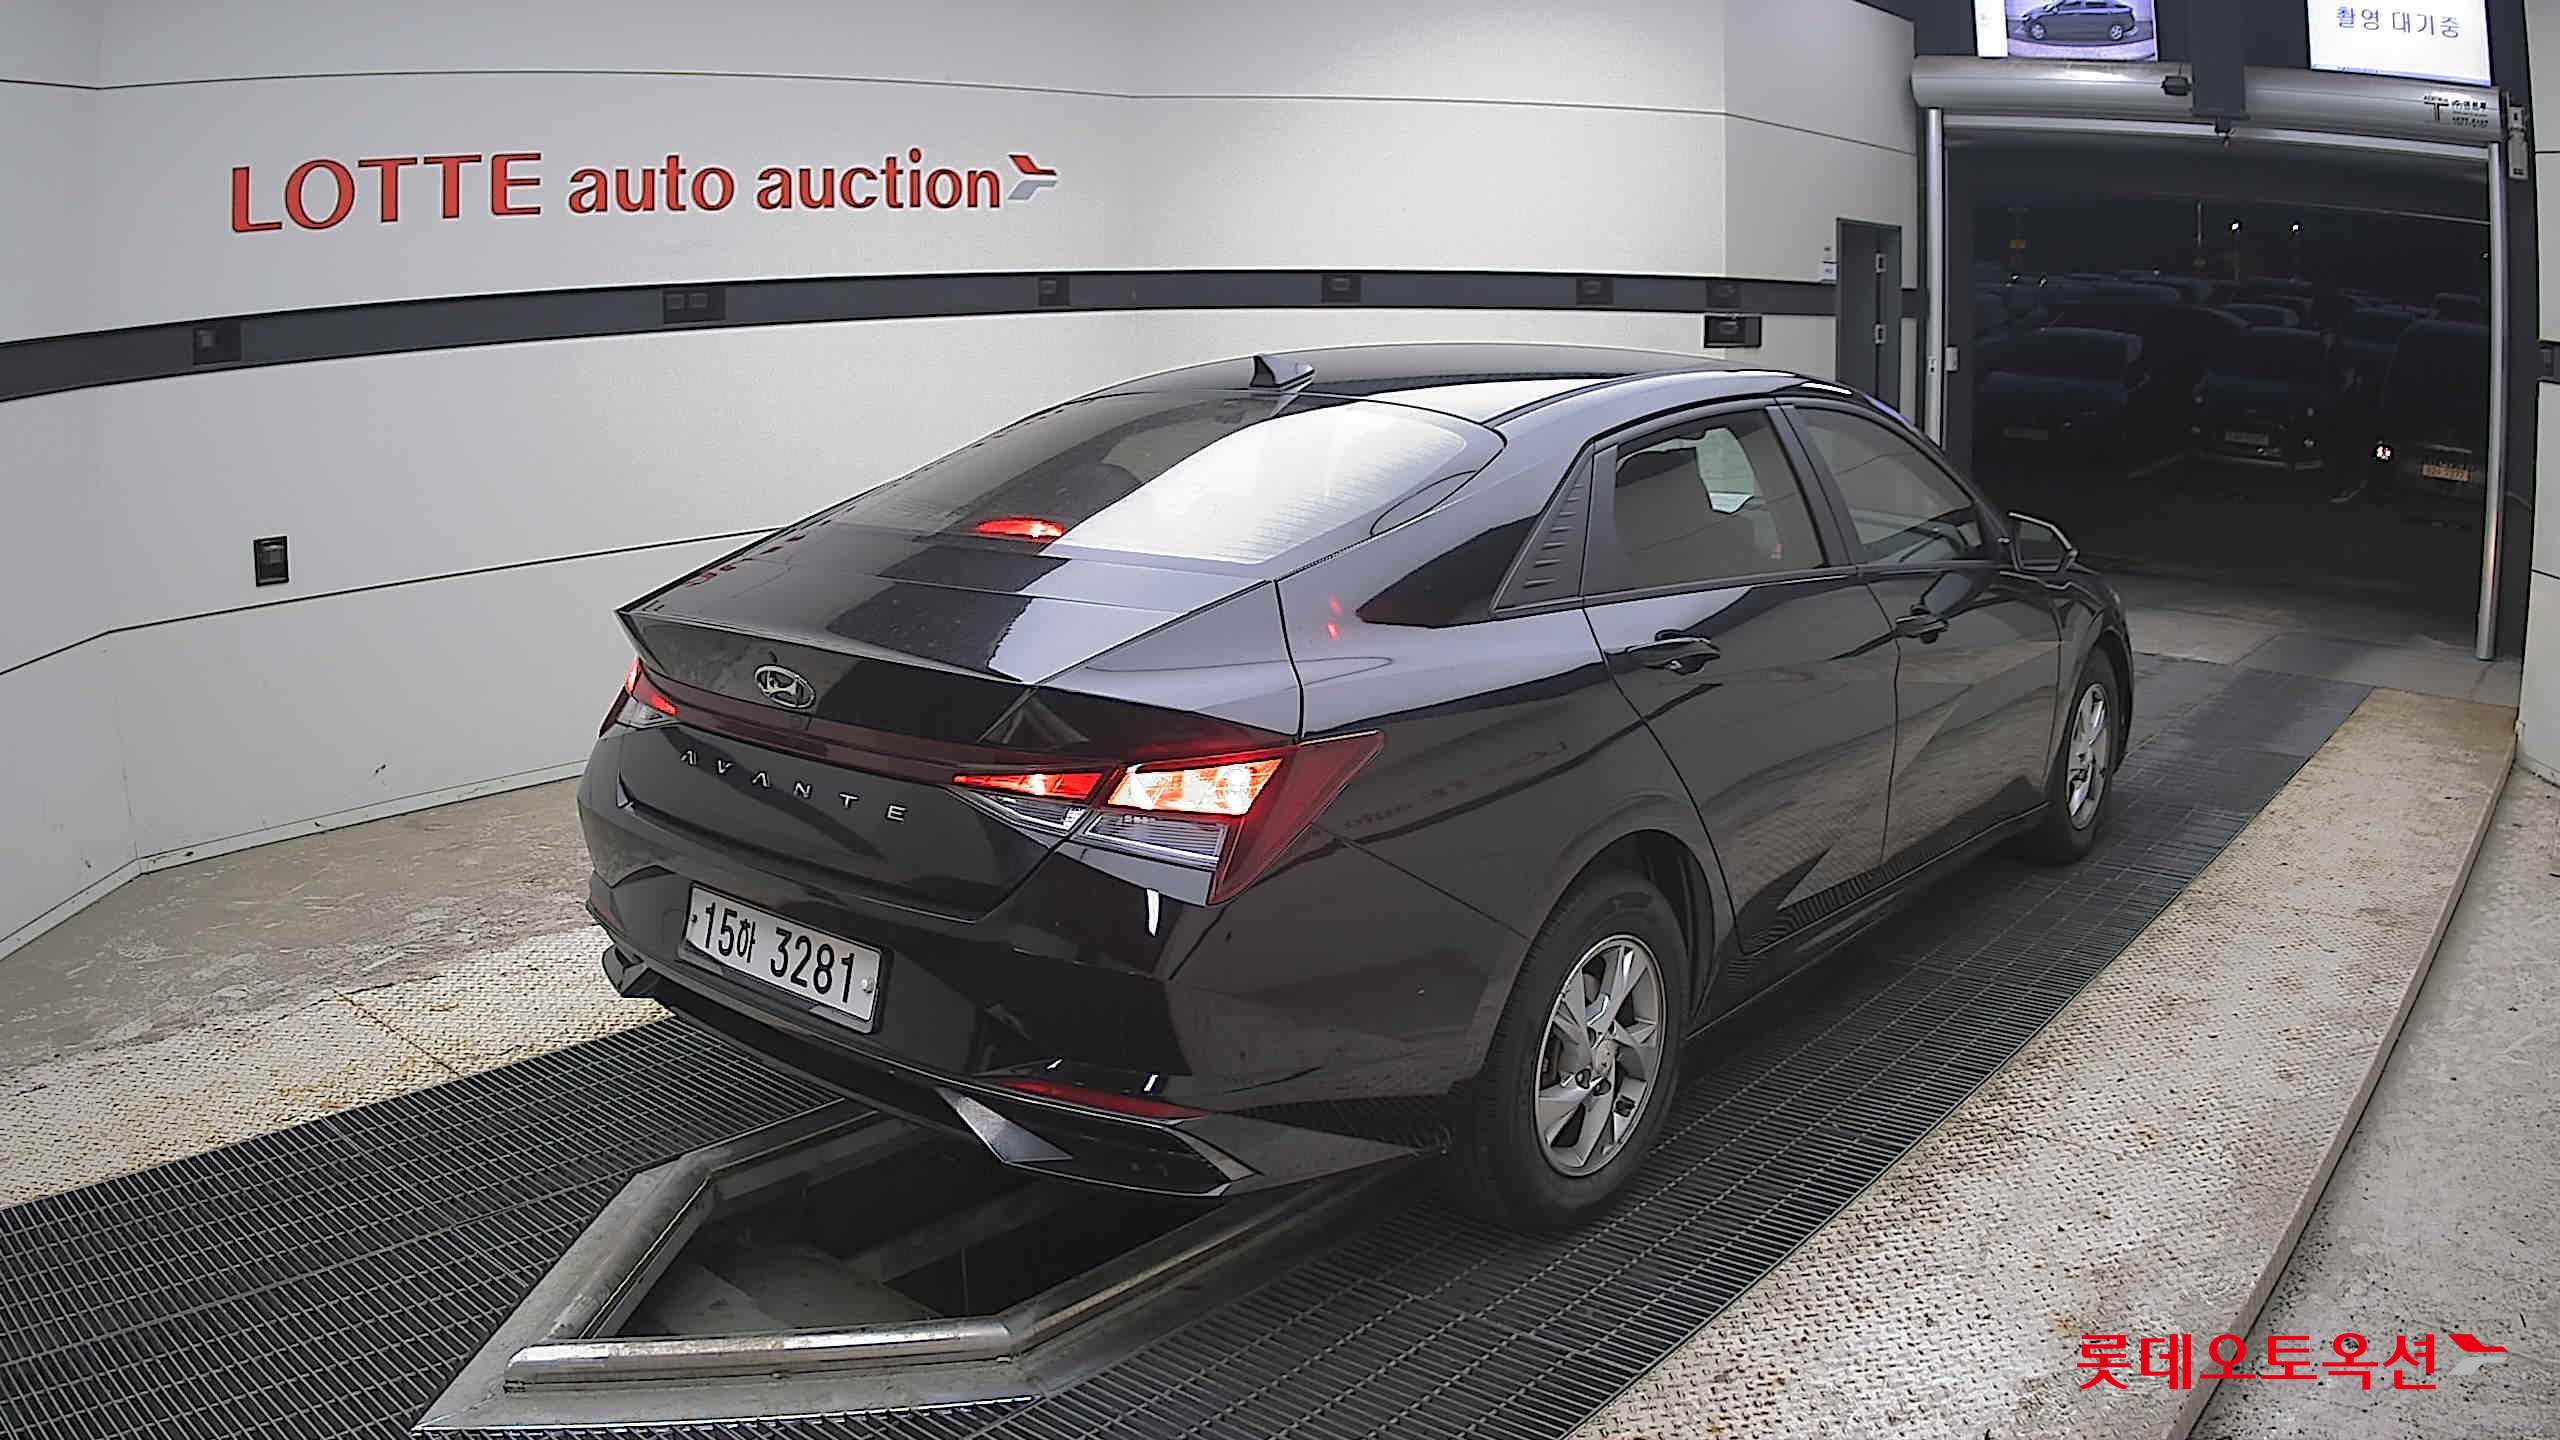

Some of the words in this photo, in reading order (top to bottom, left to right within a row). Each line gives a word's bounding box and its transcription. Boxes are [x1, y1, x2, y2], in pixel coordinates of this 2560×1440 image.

[2336, 7, 2380, 31] 촬영
[2392, 12, 2460, 38] 대기중
[231, 151, 542, 233] LOTTE
[567, 154, 735, 214] auto
[756, 147, 1001, 211] auction
[680, 750, 907, 822] AVANTE
[705, 902, 756, 963] 15하
[769, 927, 856, 1003] 3281
